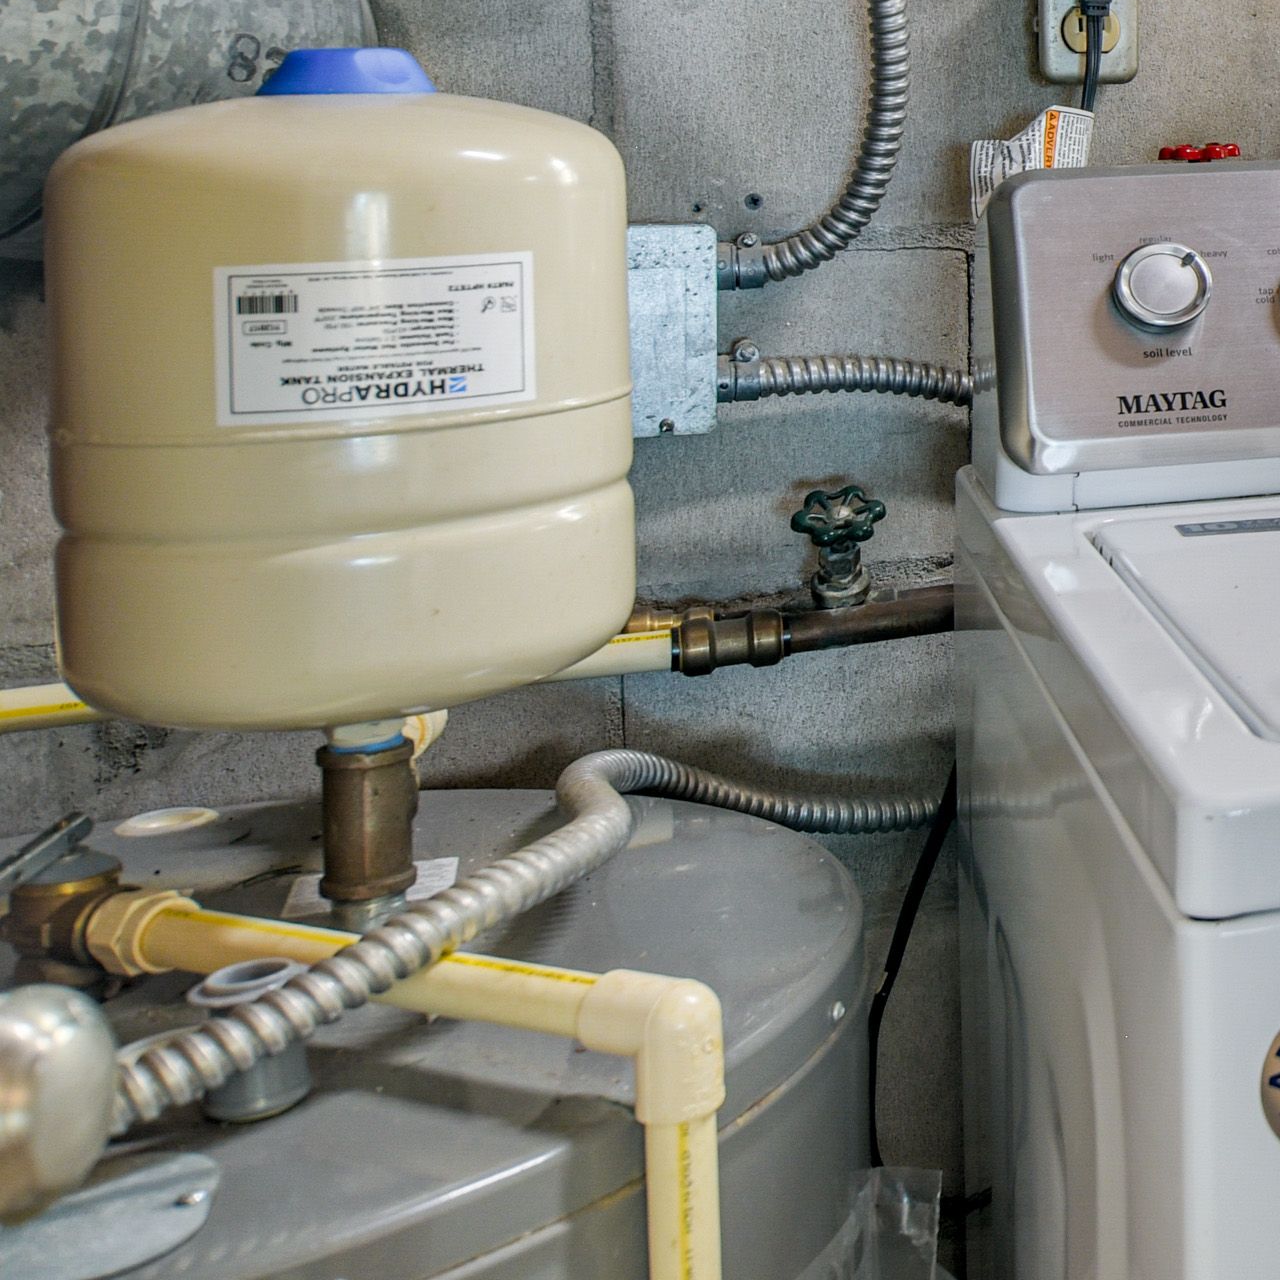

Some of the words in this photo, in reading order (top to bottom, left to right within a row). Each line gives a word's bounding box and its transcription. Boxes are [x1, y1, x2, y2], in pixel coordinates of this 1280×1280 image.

[1092, 252, 1115, 263] light
[1200, 250, 1228, 259] heavy
[1258, 287, 1274, 296] tap
[1255, 295, 1276, 304] cold
[1143, 348, 1163, 359] soil
[1166, 346, 1193, 358] level
[327, 368, 413, 383] EXPANSION
[420, 363, 484, 377] THERMAL
[279, 375, 320, 387] TANK
[302, 377, 446, 406] HYDRAPRO
[1116, 389, 1227, 415] MAYTAG
[1118, 417, 1172, 428] COMMERCIAL
[1176, 414, 1228, 424] TECHNOLOGY
